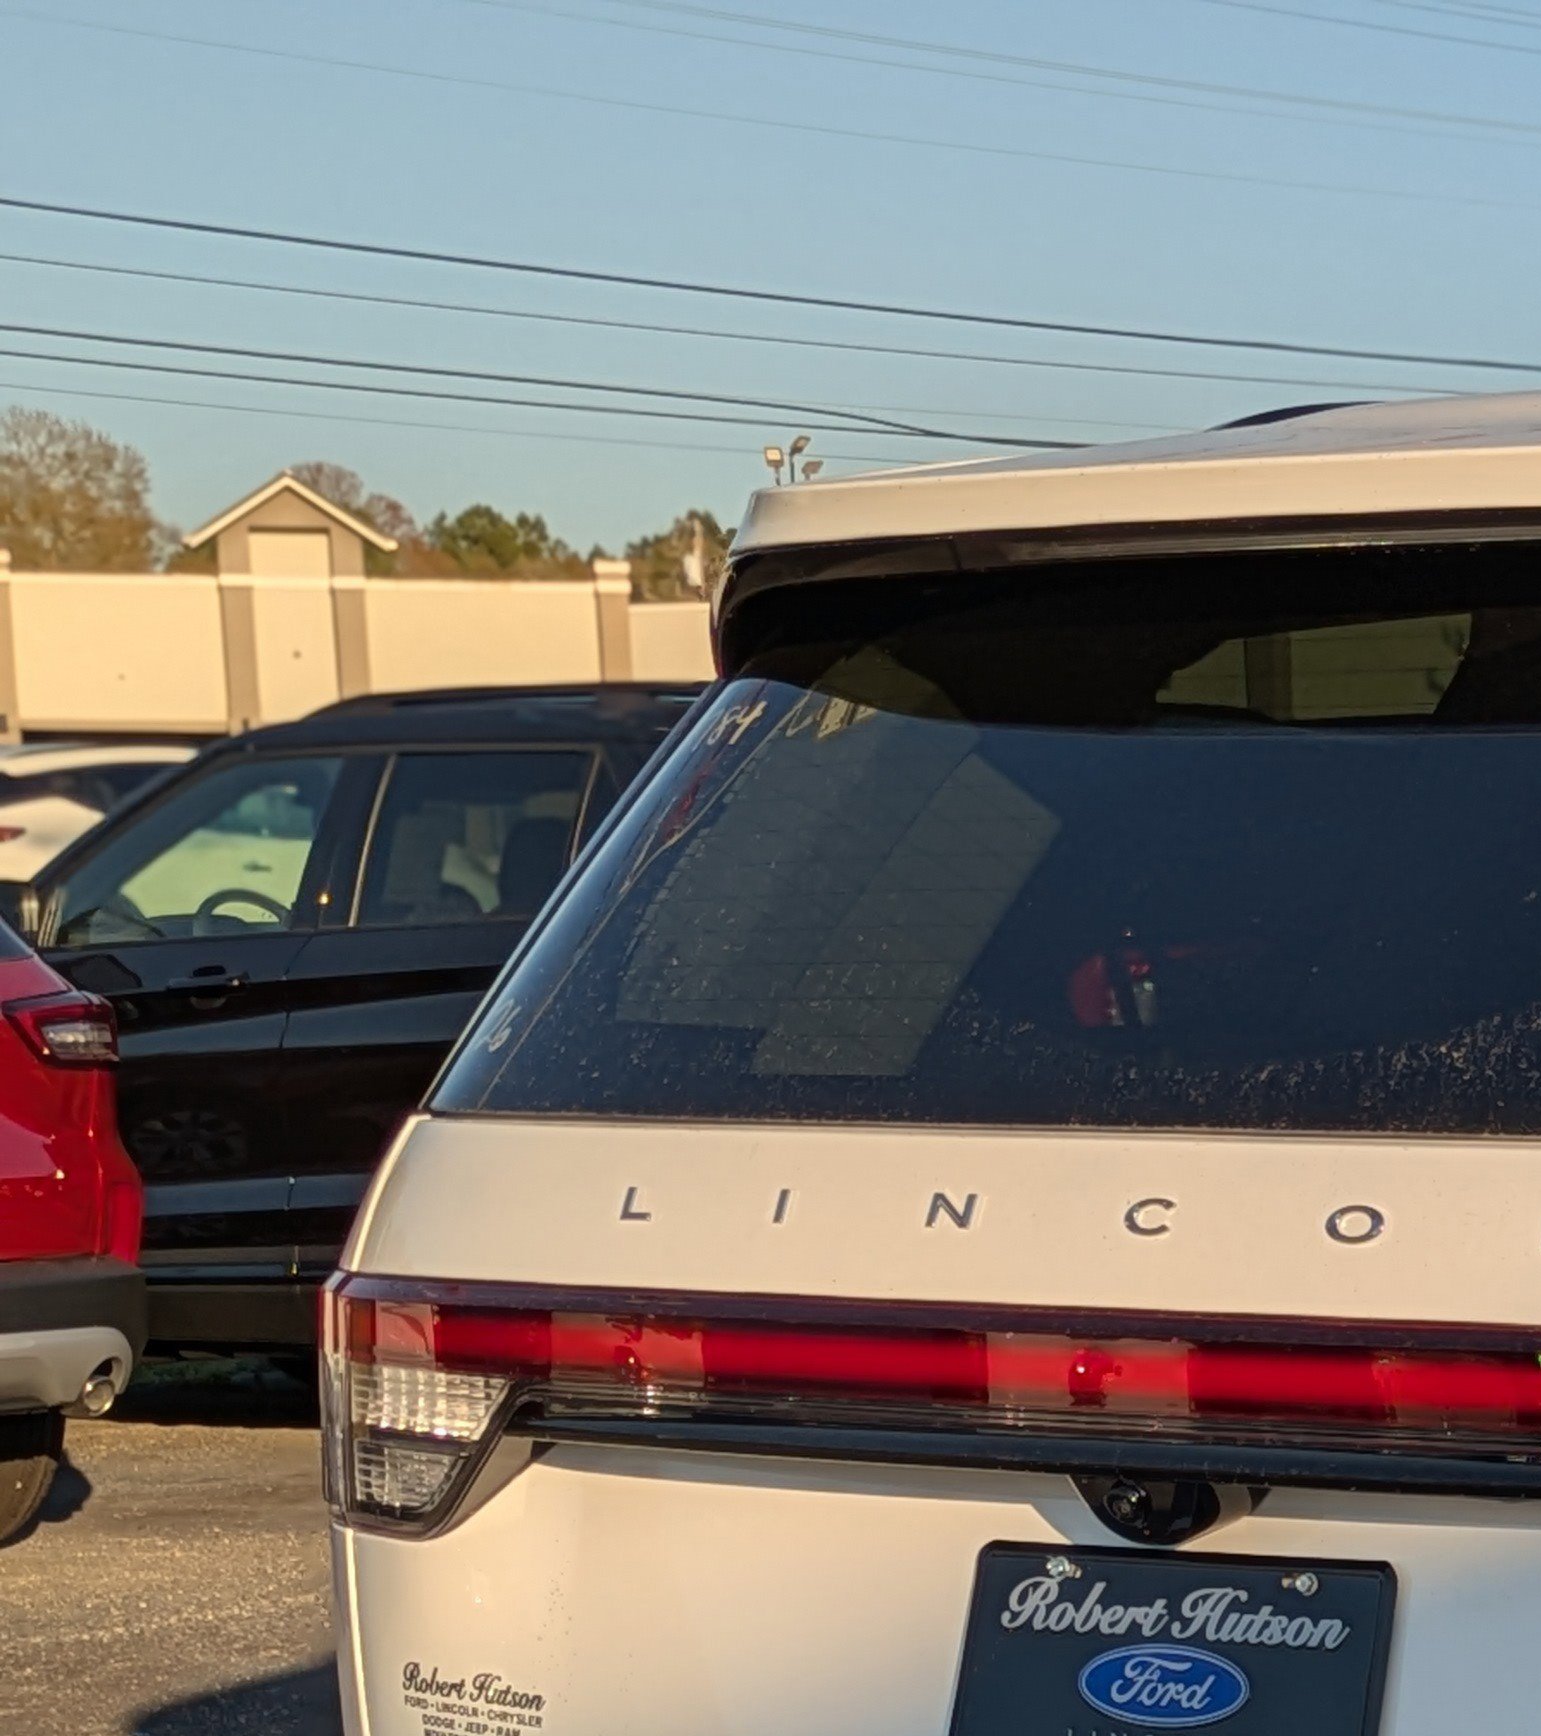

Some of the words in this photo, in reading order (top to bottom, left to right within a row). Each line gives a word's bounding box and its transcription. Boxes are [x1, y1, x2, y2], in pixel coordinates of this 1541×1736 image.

[1001, 1575, 1169, 1638] Robert
[1171, 1586, 1350, 1650] Hutson
[403, 1661, 467, 1700] Robert
[469, 1673, 546, 1711] Hutson
[1111, 1655, 1217, 1711] Ford
[405, 1695, 429, 1710] FORD
[435, 1701, 479, 1718] LINCOLN
[486, 1709, 543, 1728] CHRYSLER
[422, 1714, 456, 1731] DODGE
[464, 1721, 489, 1735] JEEP
